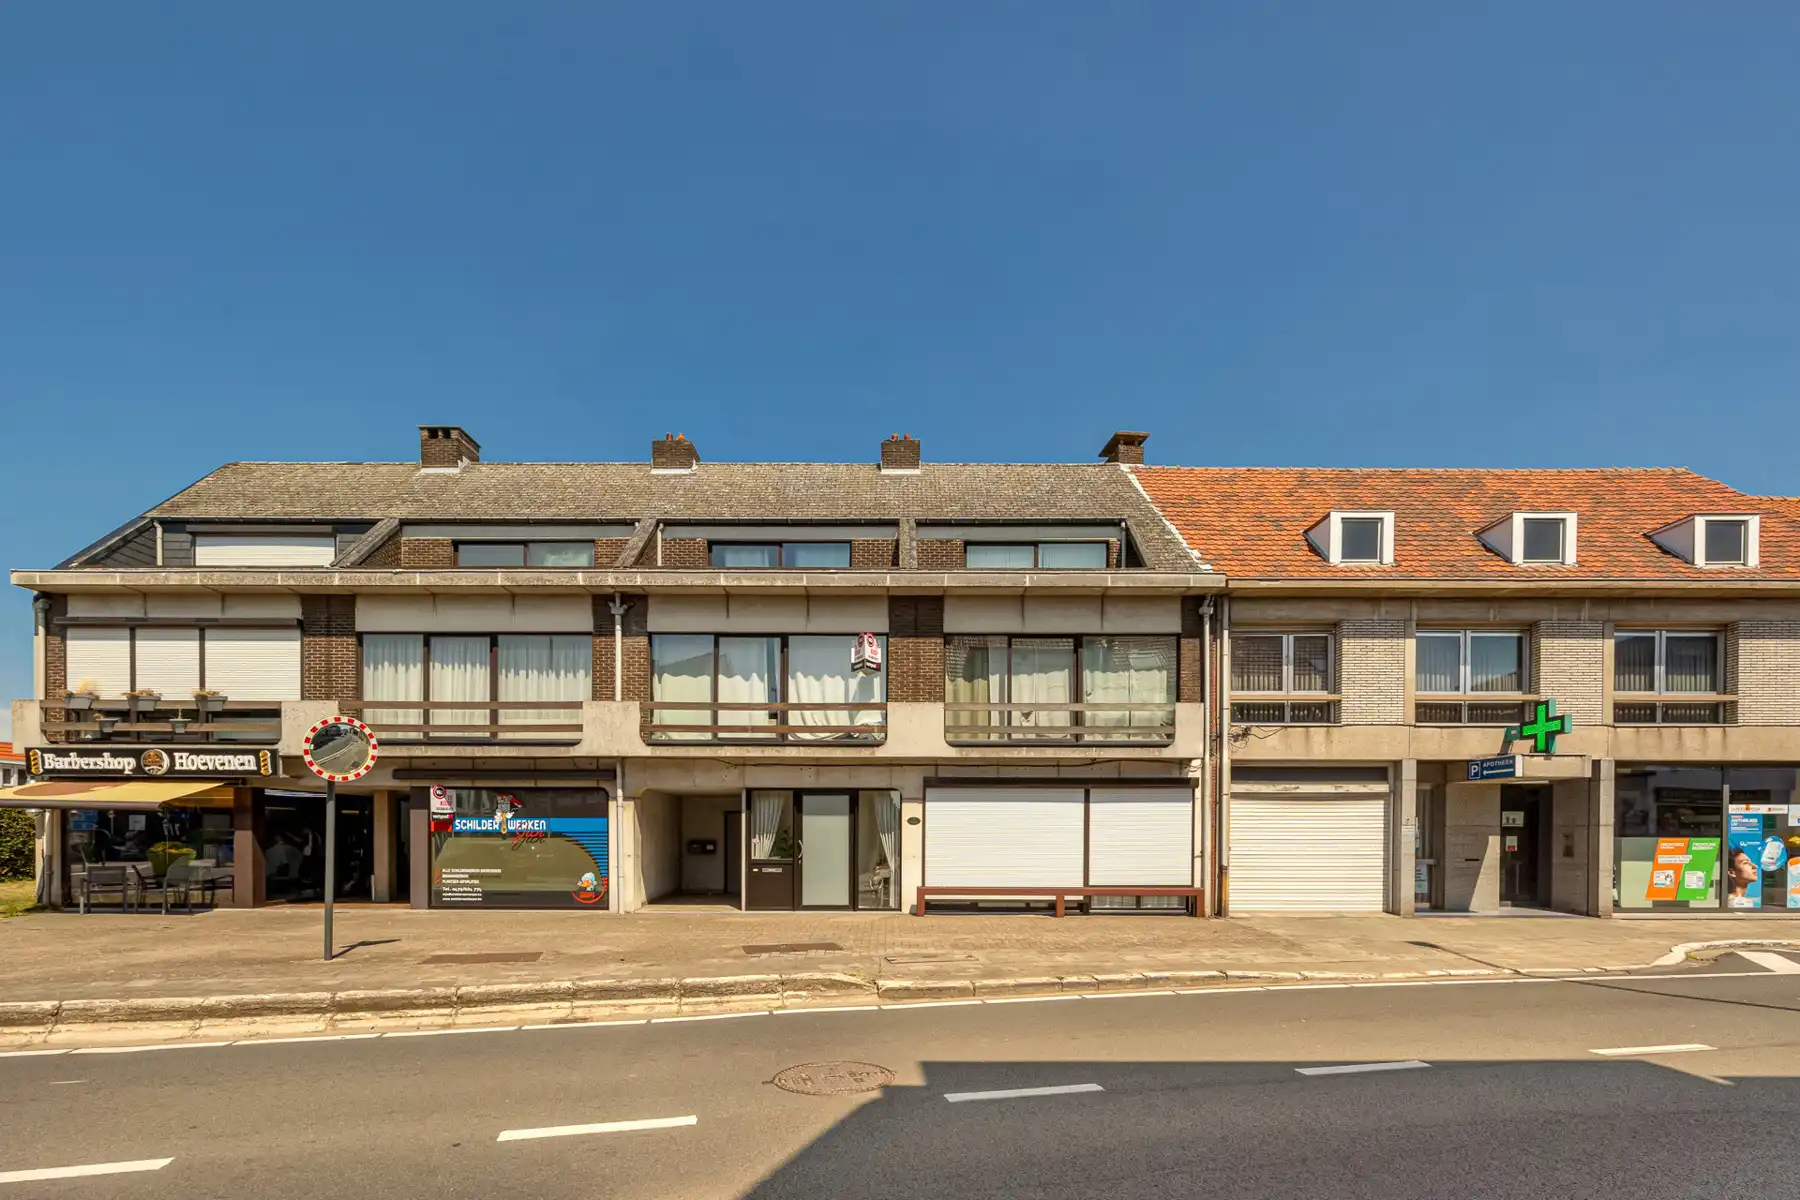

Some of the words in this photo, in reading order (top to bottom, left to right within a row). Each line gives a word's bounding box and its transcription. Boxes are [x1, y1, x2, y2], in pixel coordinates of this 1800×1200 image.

[43, 752, 137, 774] Barbershop
[173, 752, 257, 770] Hoevenen
[1482, 760, 1514, 768] APOTHEEK
[1471, 765, 1479, 776] P
[455, 819, 500, 830] SCHILDER
[507, 819, 546, 830] WERKEN
